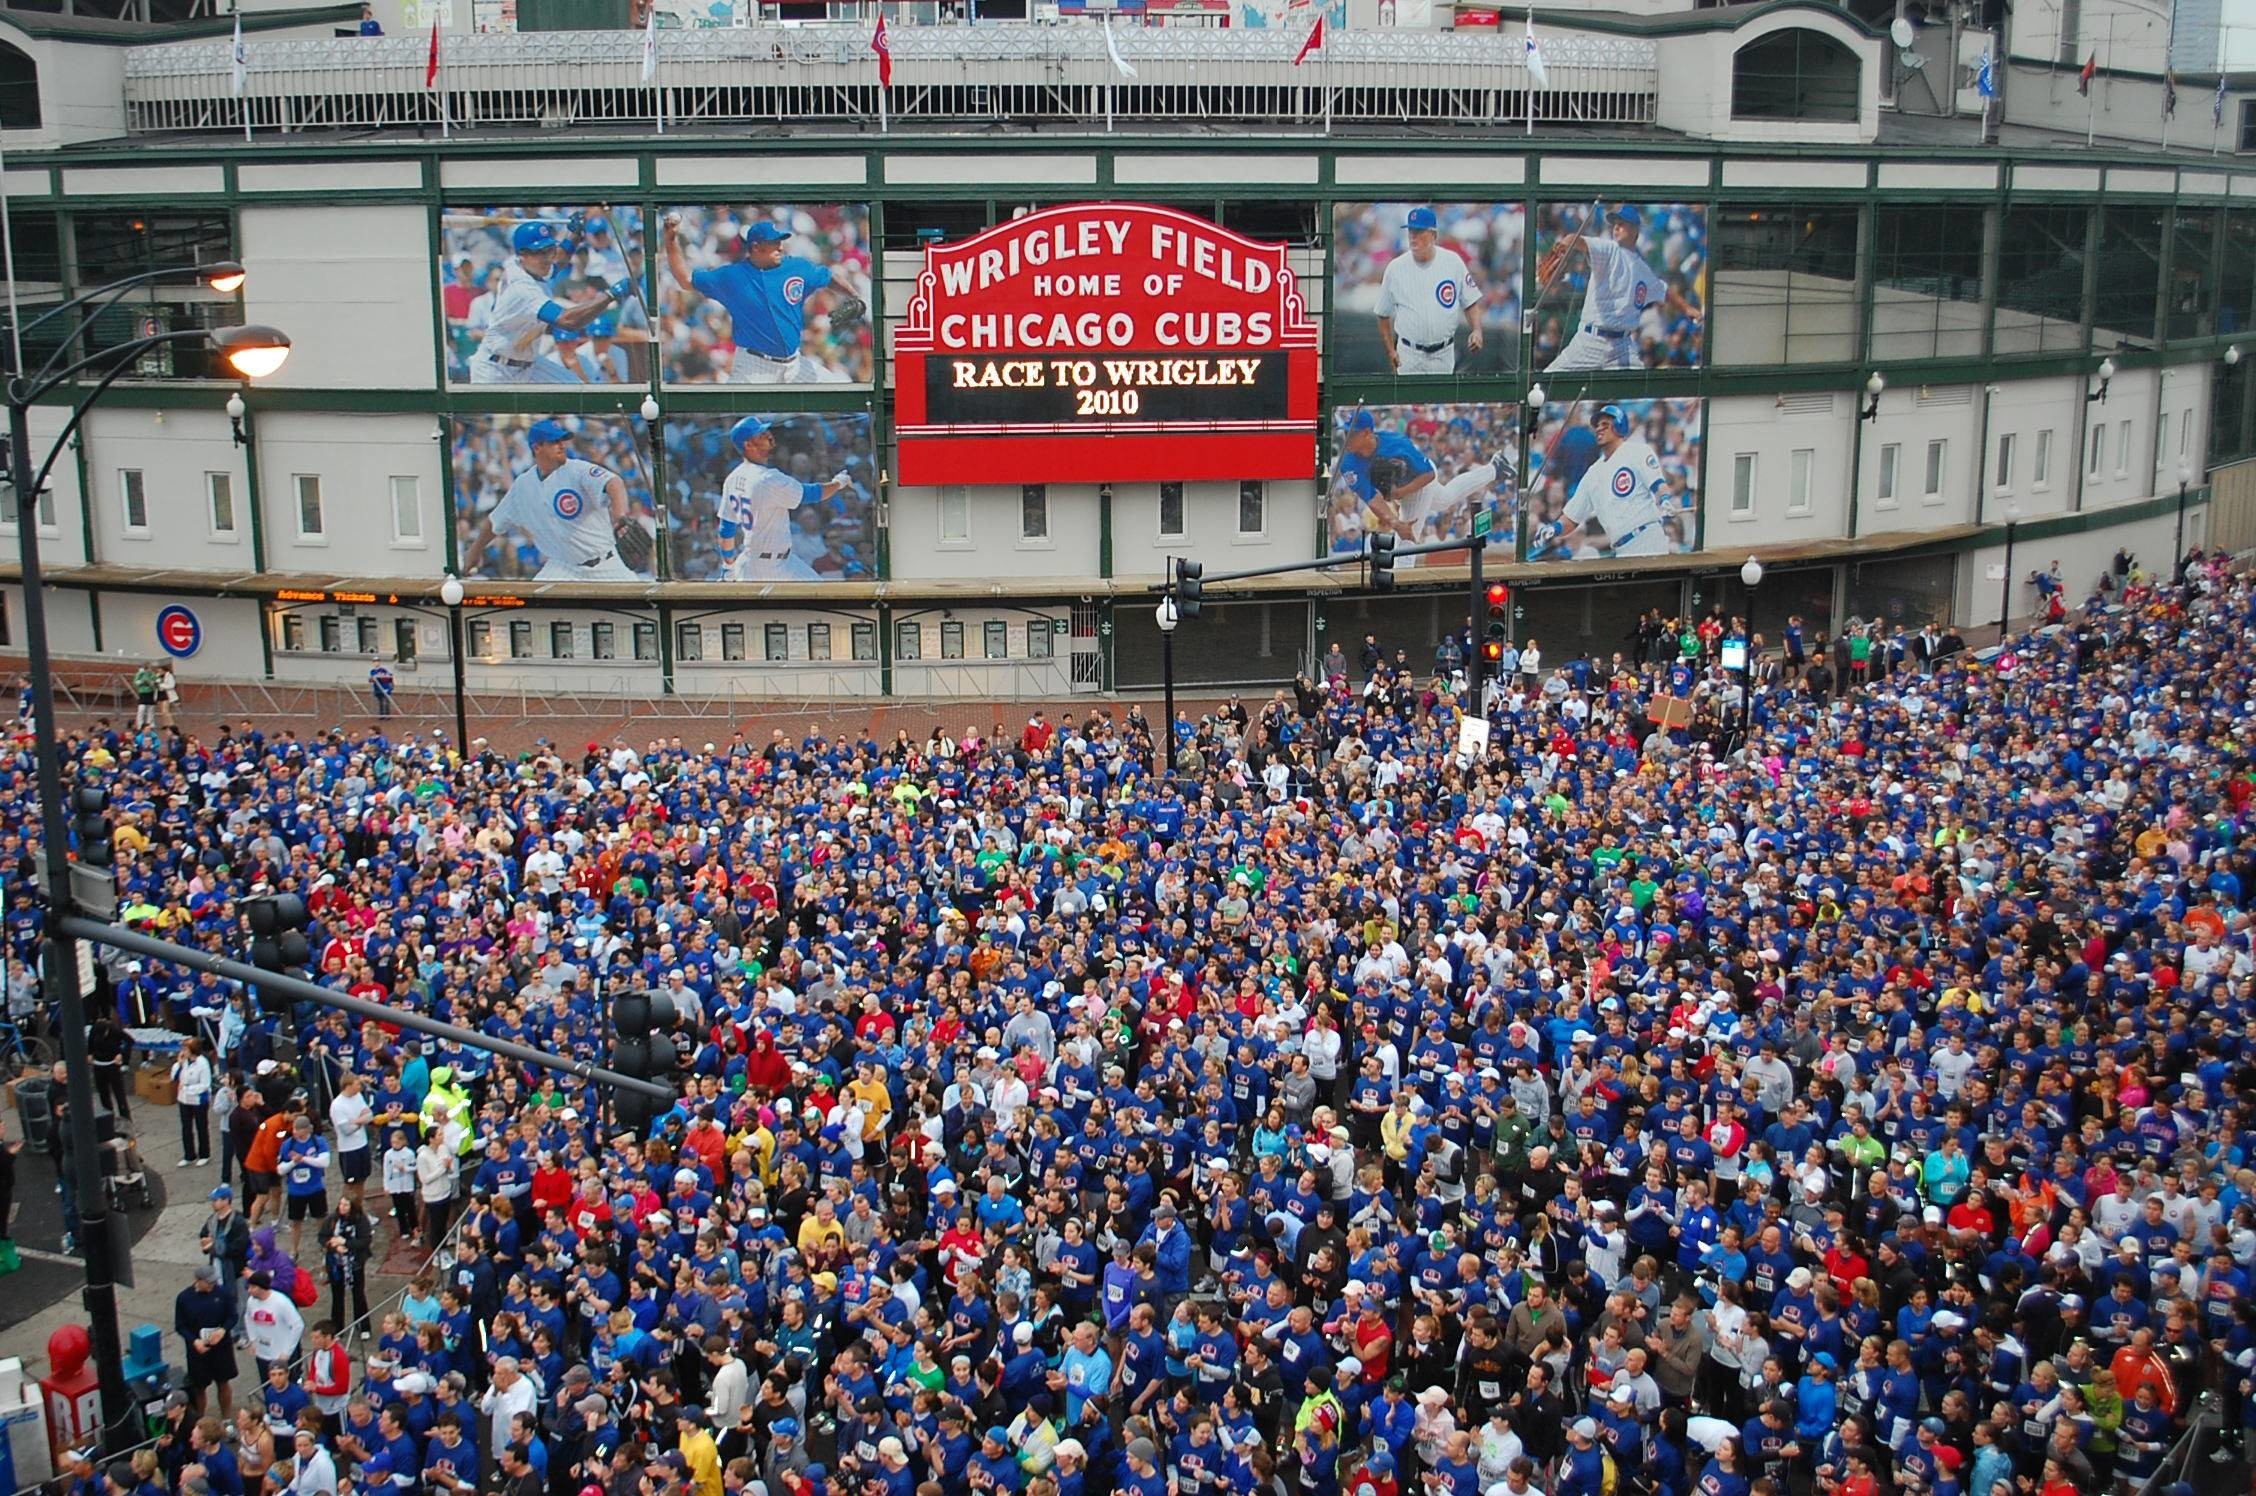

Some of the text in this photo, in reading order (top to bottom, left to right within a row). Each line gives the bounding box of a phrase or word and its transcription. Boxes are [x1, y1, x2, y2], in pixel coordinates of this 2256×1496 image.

[940, 220, 1272, 298] WRIGLEY FIELD
[1034, 274, 1183, 297] HOME OF
[940, 311, 1273, 349] CHICAGO CUBS
[952, 359, 1261, 388] RACE TO WRIGLEY
[1076, 390, 1139, 415] 2010
[729, 494, 754, 531] 35
